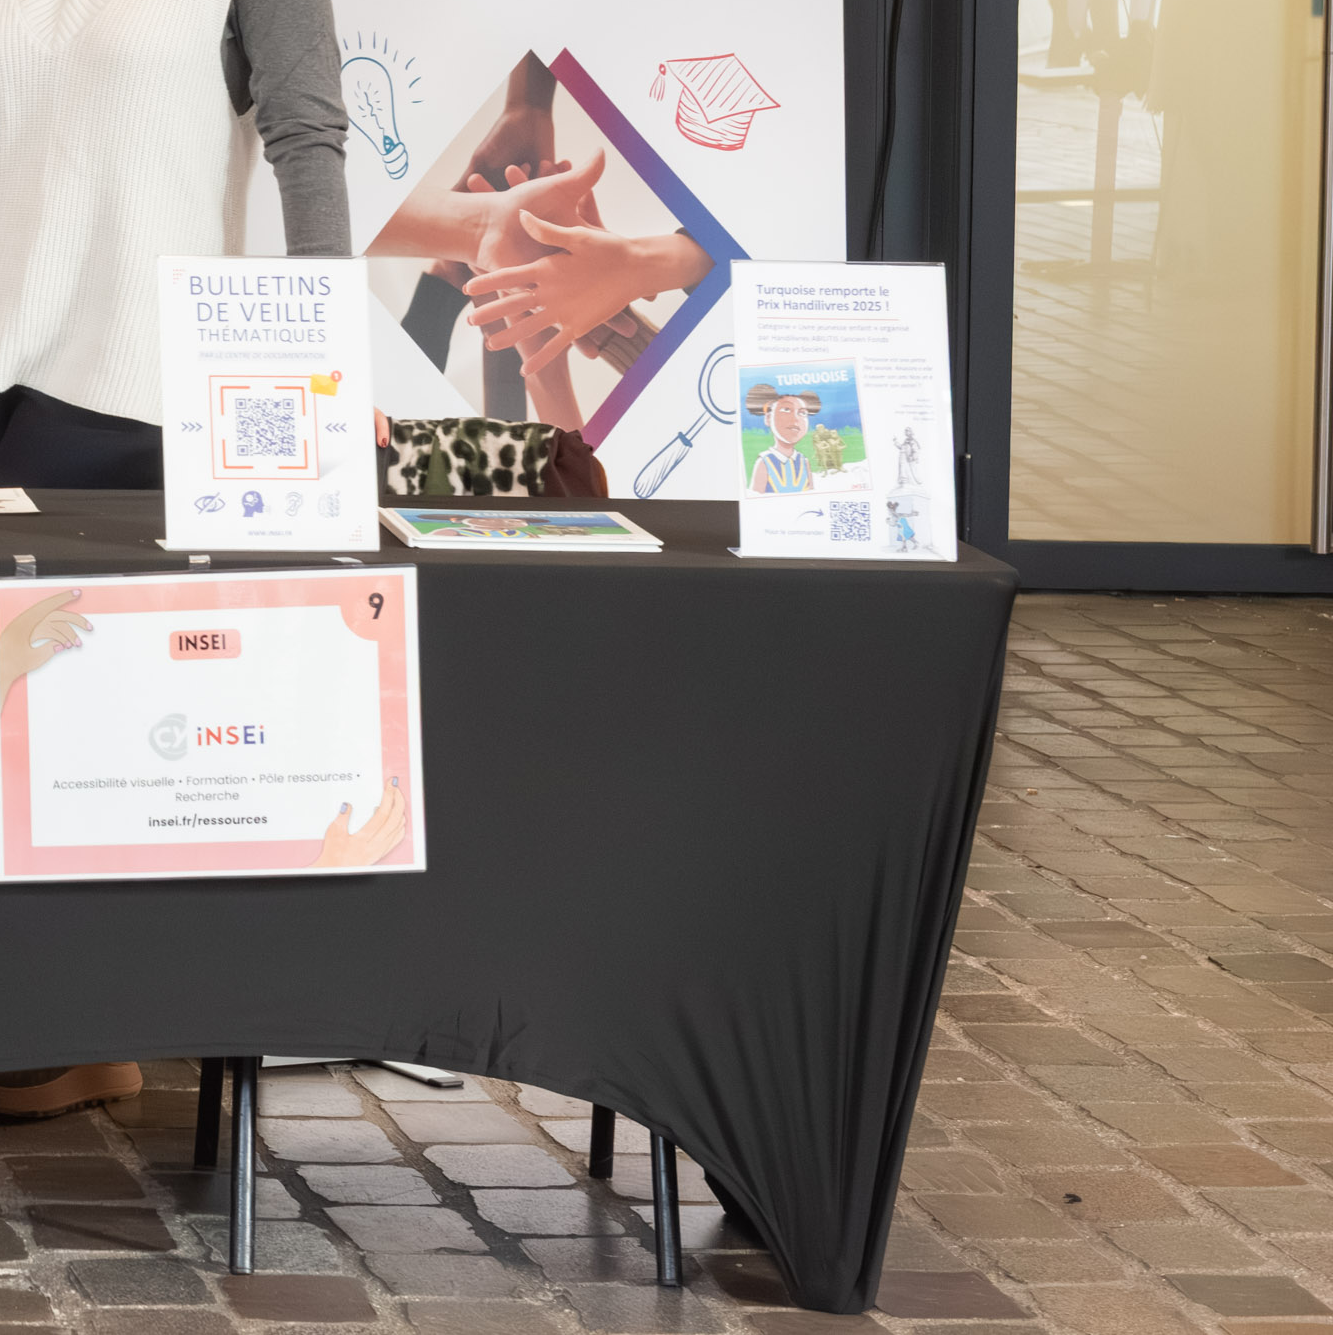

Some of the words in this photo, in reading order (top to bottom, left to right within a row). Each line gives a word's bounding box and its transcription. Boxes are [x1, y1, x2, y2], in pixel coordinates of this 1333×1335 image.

[190, 276, 331, 296] BULLETINS
[756, 284, 816, 297] Turquoise
[819, 286, 876, 298] remporte
[879, 286, 889, 297] le
[197, 302, 229, 322] DE
[240, 302, 326, 322] VEILLE
[757, 300, 780, 310] Prix
[783, 300, 849, 311] Handilivres
[853, 301, 881, 311] 2025
[197, 325, 326, 343] THÉMATIQUES
[776, 370, 848, 386] TURQUOISE
[368, 592, 384, 620] 9
[178, 633, 226, 651] INSEI
[53, 777, 127, 790] Accessibilité
[130, 776, 175, 788] visuelle
[186, 774, 248, 786] Formation
[259, 772, 284, 785] Pôle
[287, 772, 353, 784] ressources
[175, 790, 239, 802] Recherche
[148, 814, 268, 828] insei.fr/ressources
